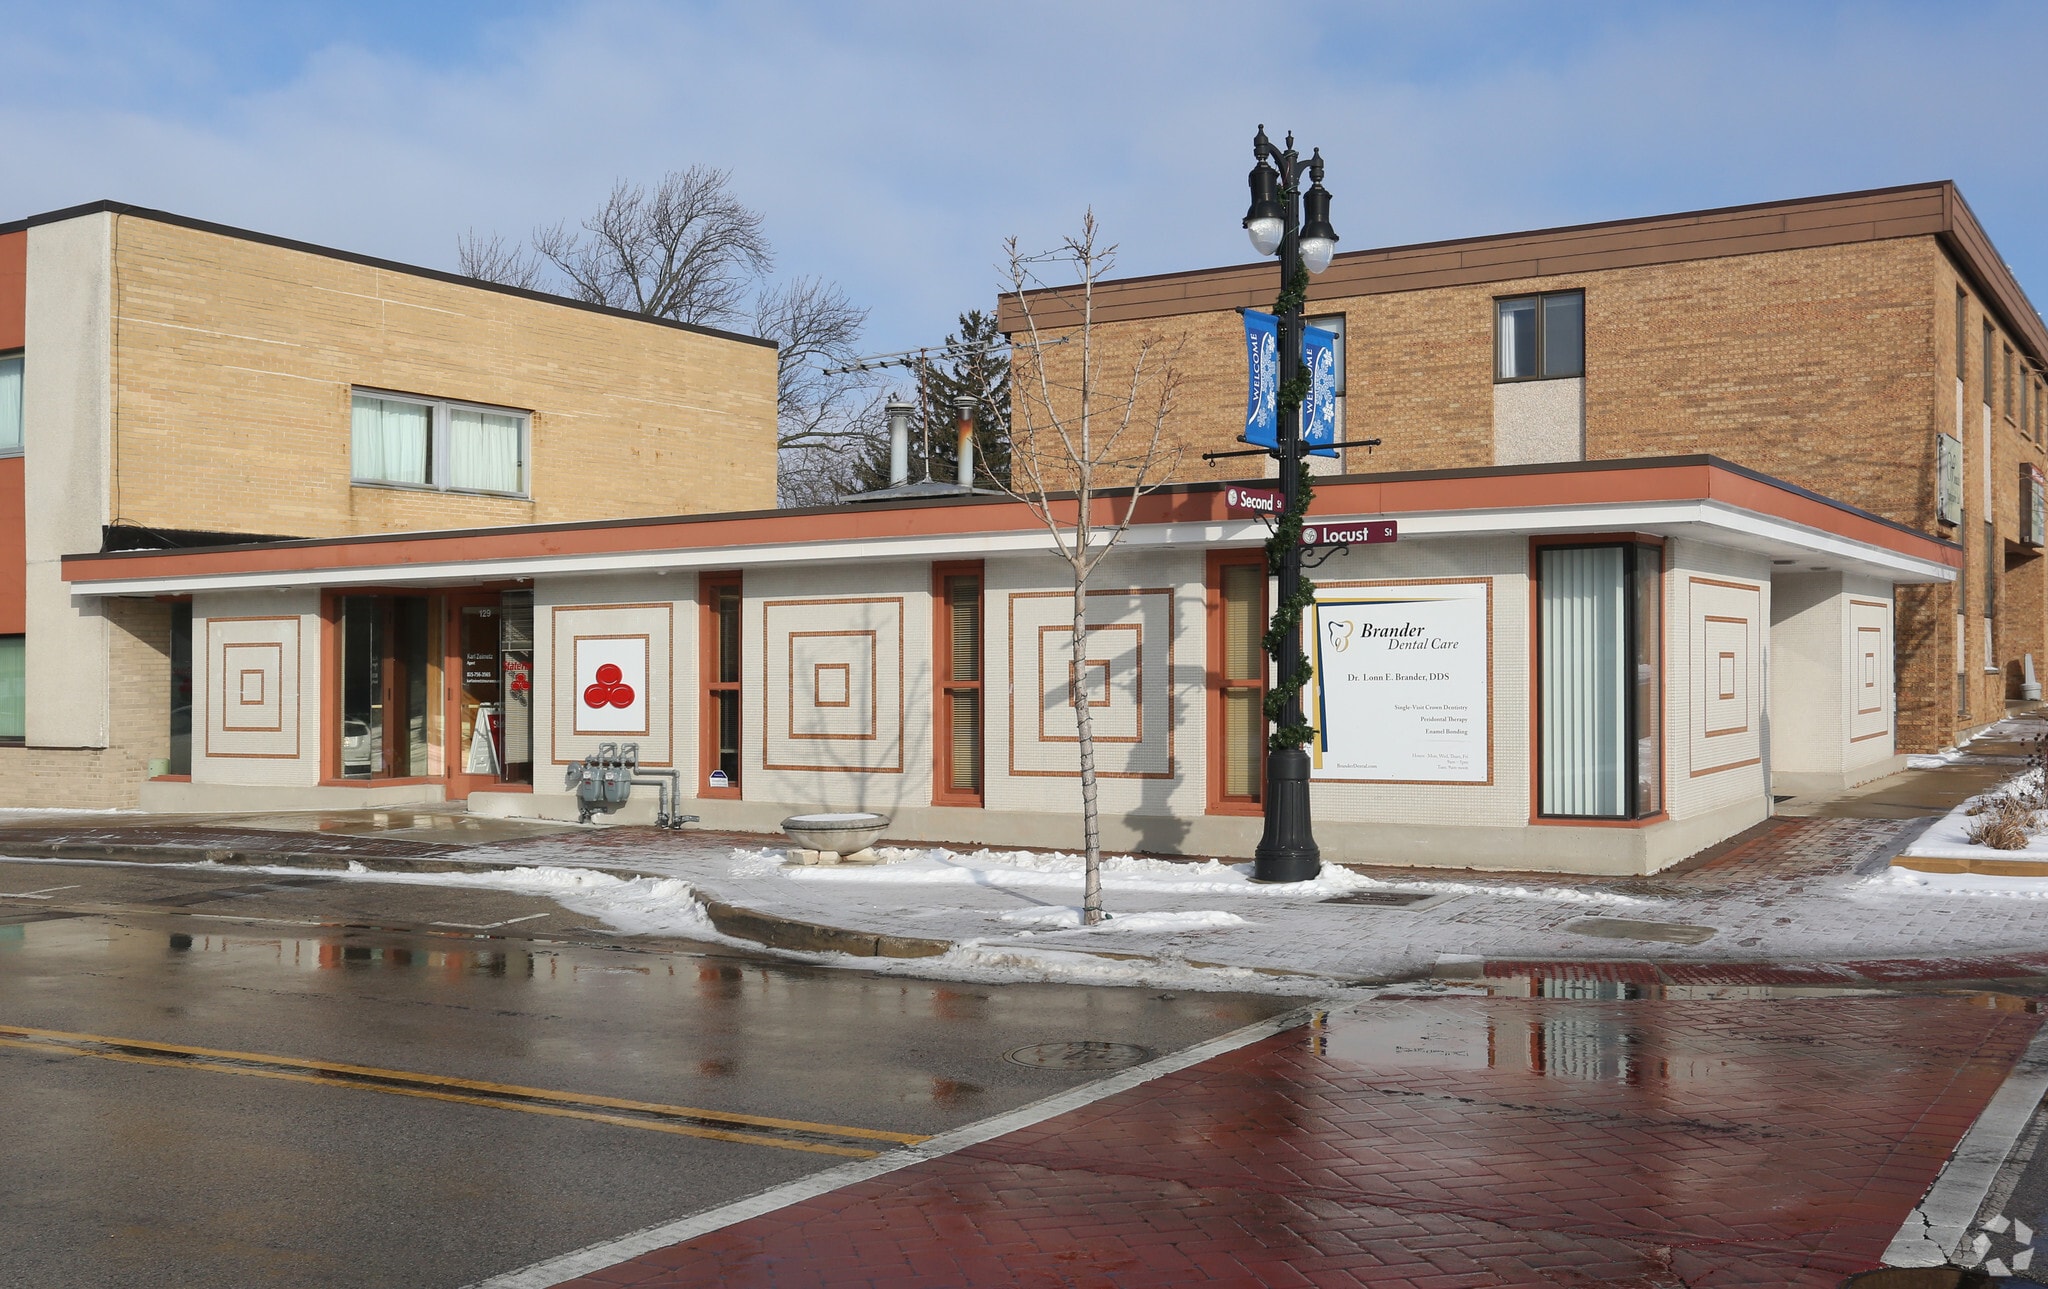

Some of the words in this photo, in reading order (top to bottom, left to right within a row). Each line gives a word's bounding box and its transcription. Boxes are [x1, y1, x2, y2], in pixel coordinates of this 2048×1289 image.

[1250, 333, 1260, 401] WELCOME
[1240, 491, 1274, 511] Second
[1276, 499, 1282, 509] St
[1323, 527, 1369, 543] Locust
[1384, 528, 1393, 537] St
[479, 609, 491, 618] 129
[1361, 622, 1425, 638] Brander
[1388, 638, 1428, 650] Dental
[1431, 638, 1459, 650] Care
[1347, 674, 1360, 682] Dr.
[1363, 674, 1383, 682] Lonn
[1395, 673, 1428, 682] Brander,
[1429, 673, 1450, 681] DDS
[1446, 728, 1468, 736] Bonding
